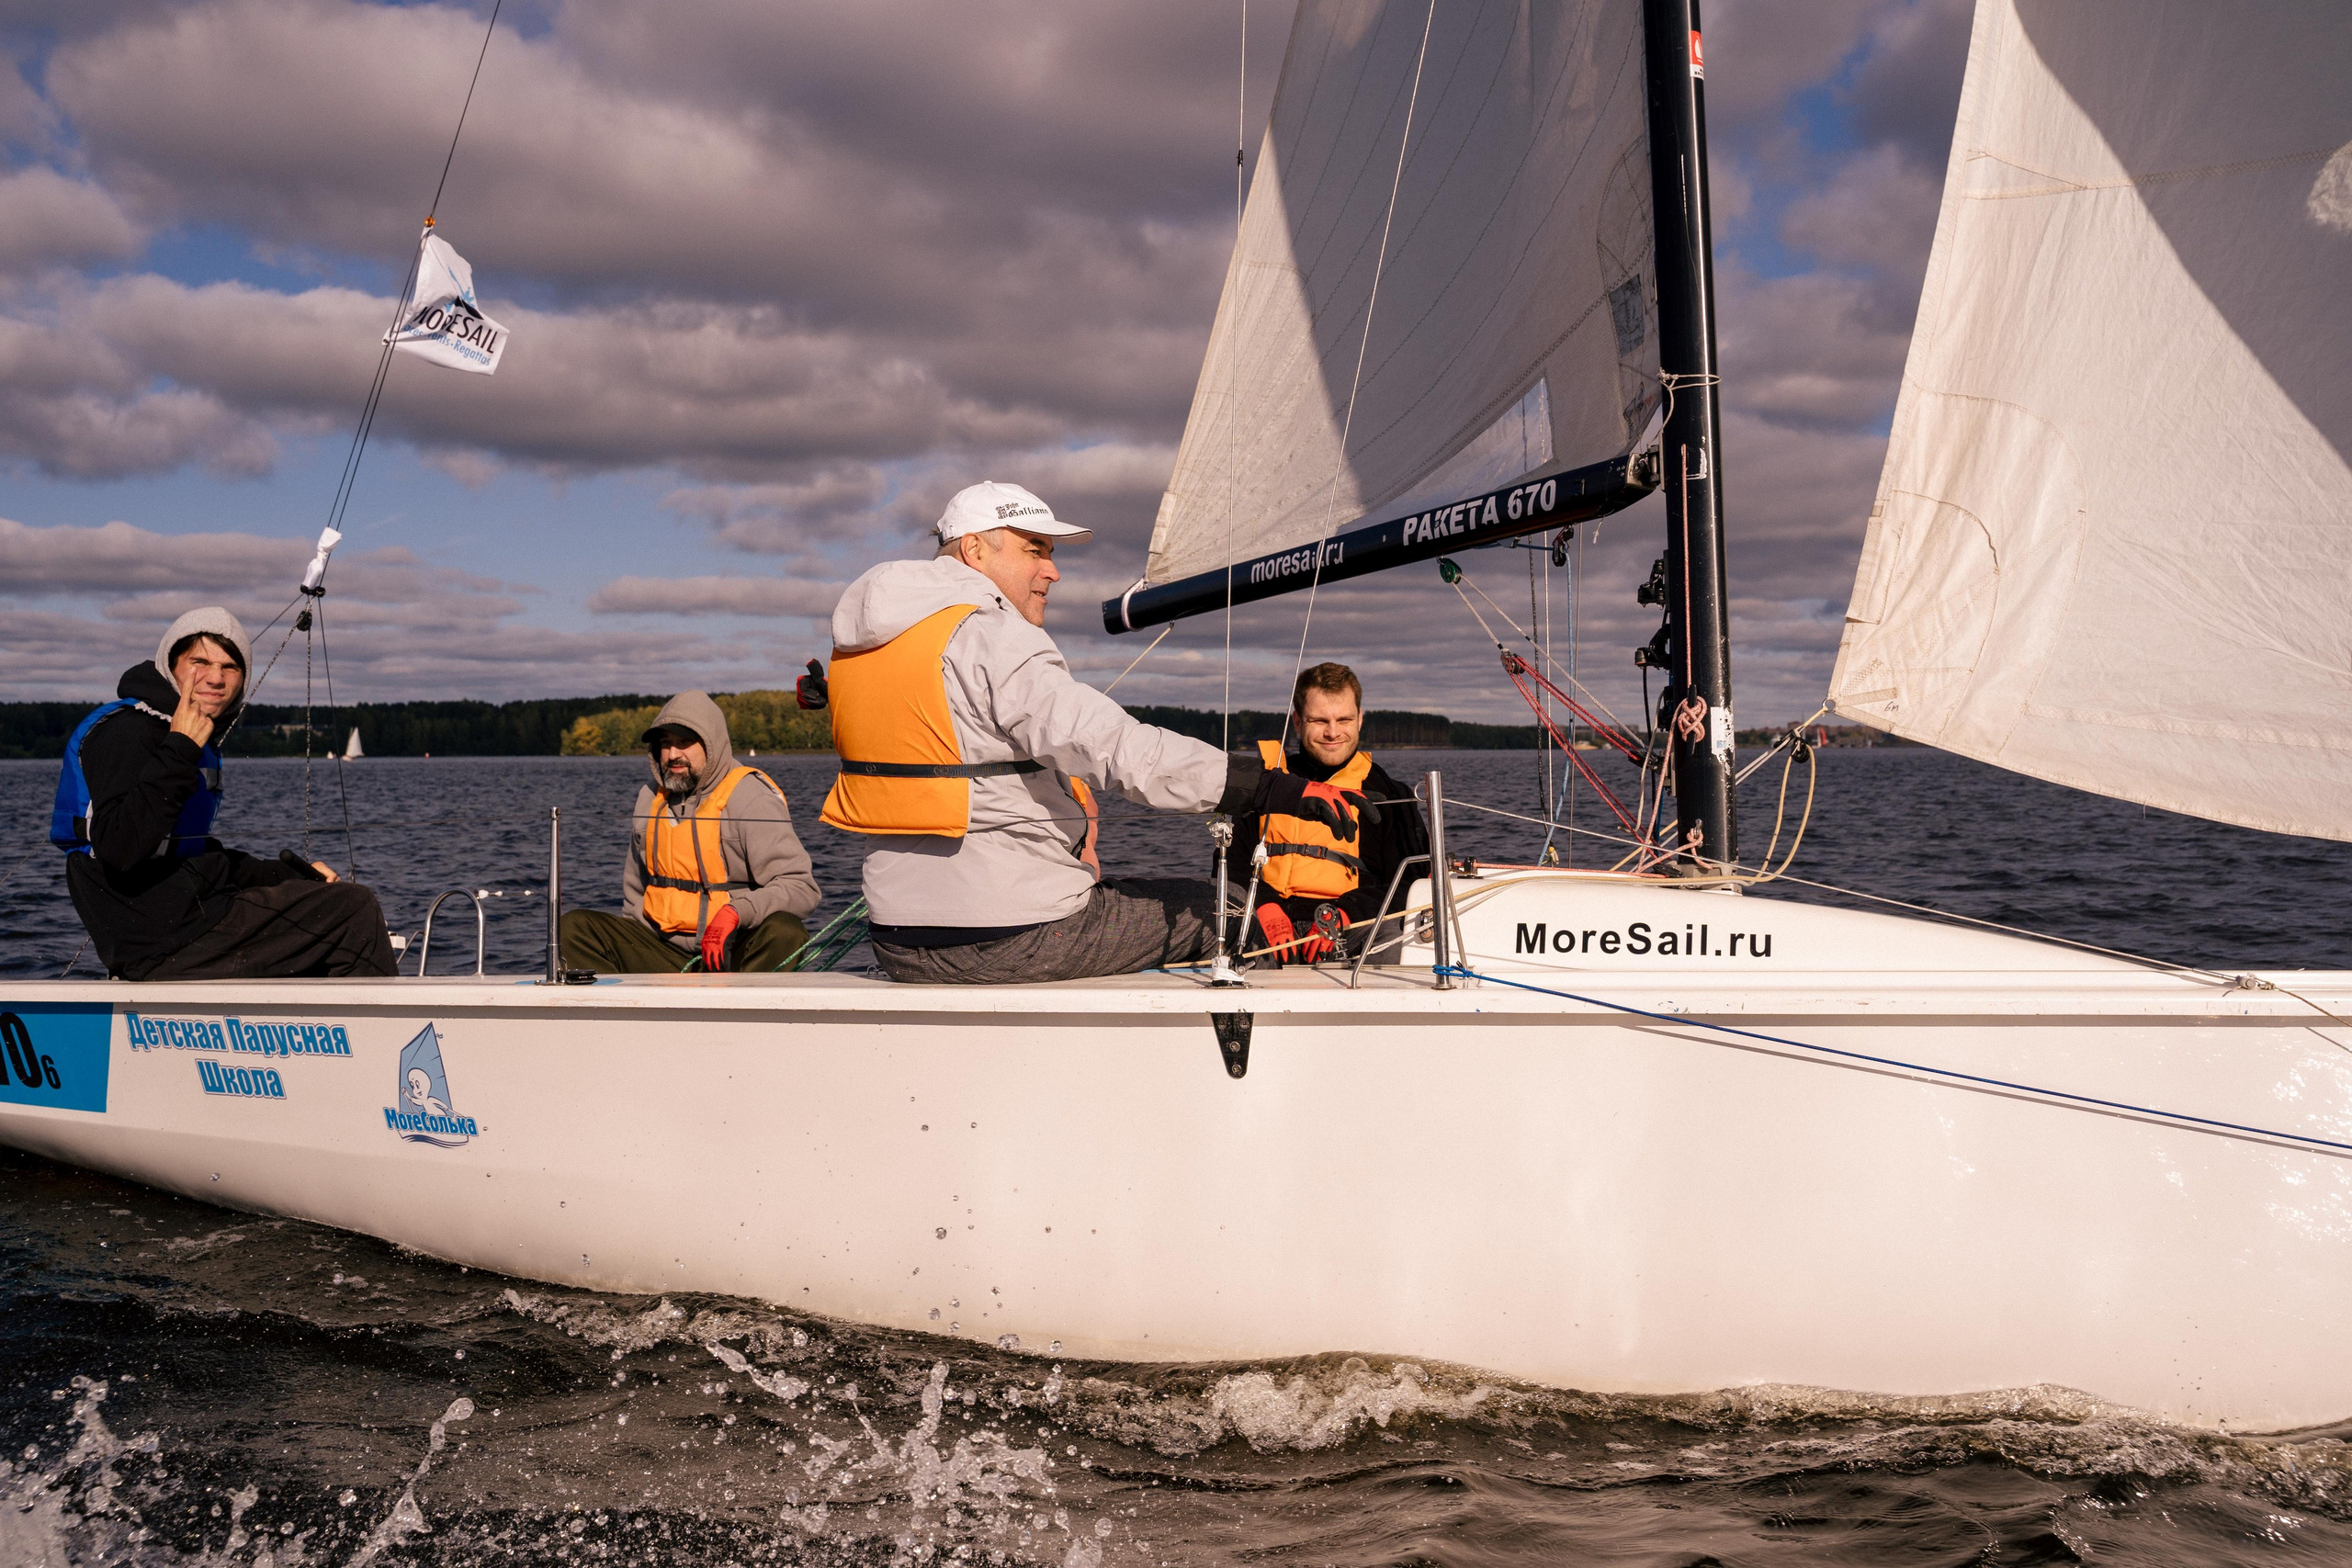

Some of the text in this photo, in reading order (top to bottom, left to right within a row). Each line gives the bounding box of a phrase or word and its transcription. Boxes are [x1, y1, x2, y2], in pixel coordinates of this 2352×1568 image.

[453, 339, 491, 367] Regattas
[1508, 479, 1556, 520] 670
[1515, 922, 1771, 957] MoreSail.ru
[125, 1011, 353, 1057] Детская Парусная
[196, 1059, 287, 1100] Школа
